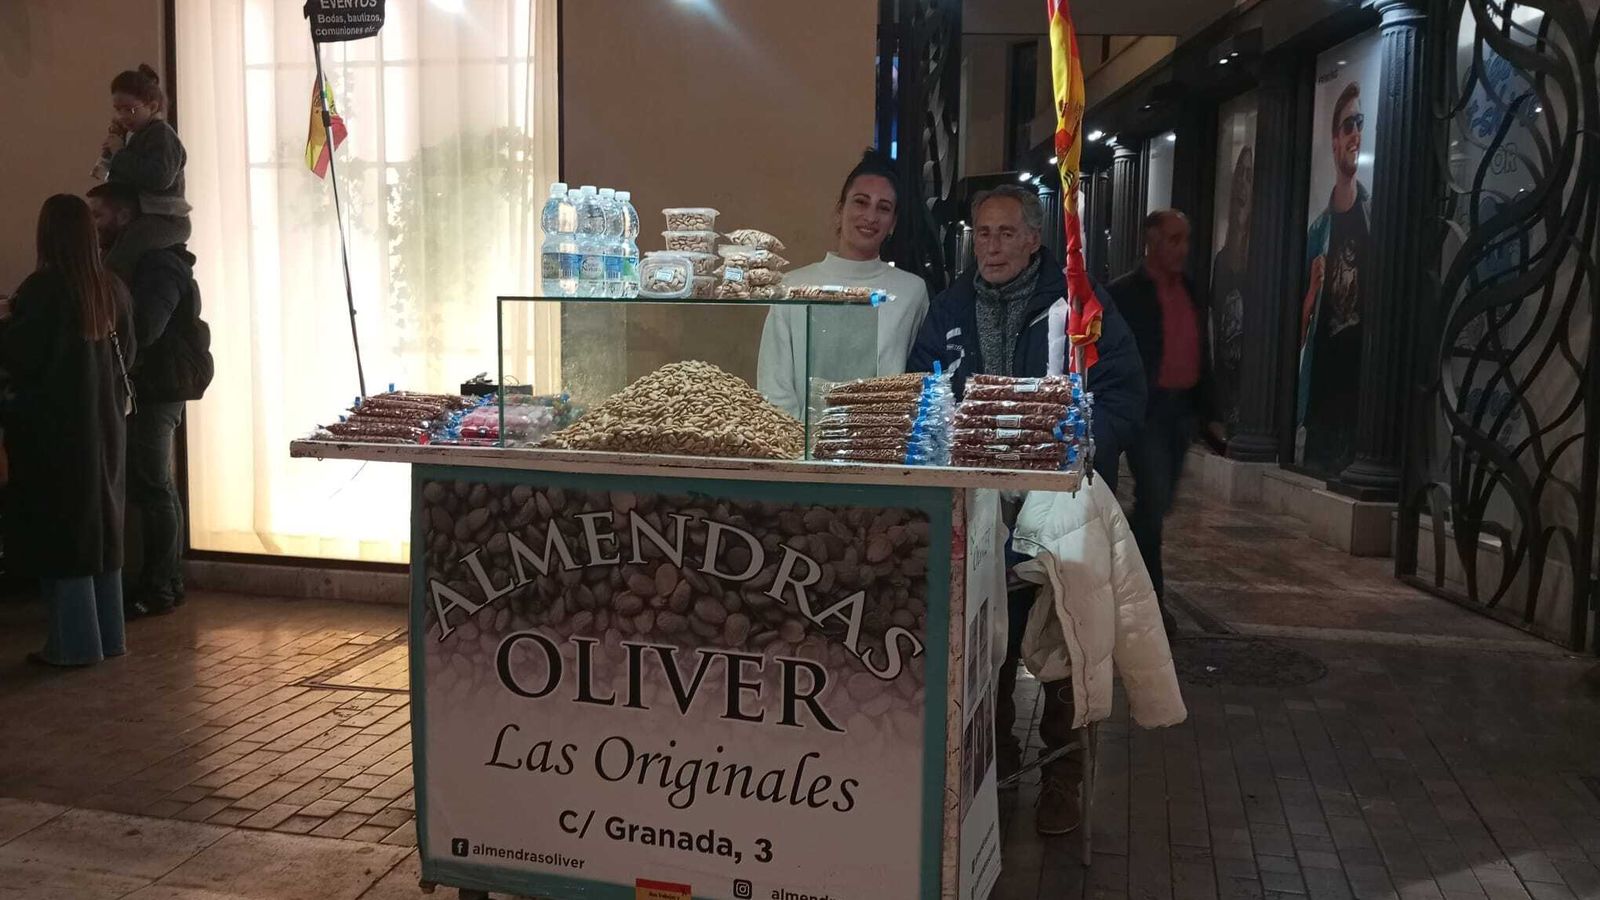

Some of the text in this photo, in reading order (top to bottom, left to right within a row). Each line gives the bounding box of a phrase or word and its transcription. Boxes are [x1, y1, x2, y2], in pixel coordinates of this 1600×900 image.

[317, 13, 382, 24] Bodas, bautizos,
[320, 0, 377, 9] EVENTOS
[315, 27, 363, 36] comuniones
[427, 508, 925, 682] ALMENDRAS
[495, 631, 846, 733] OLIVER
[484, 723, 859, 813] Las Originales
[472, 843, 586, 870] almendrasoliver
[558, 809, 774, 865] C/ Granada, 3
